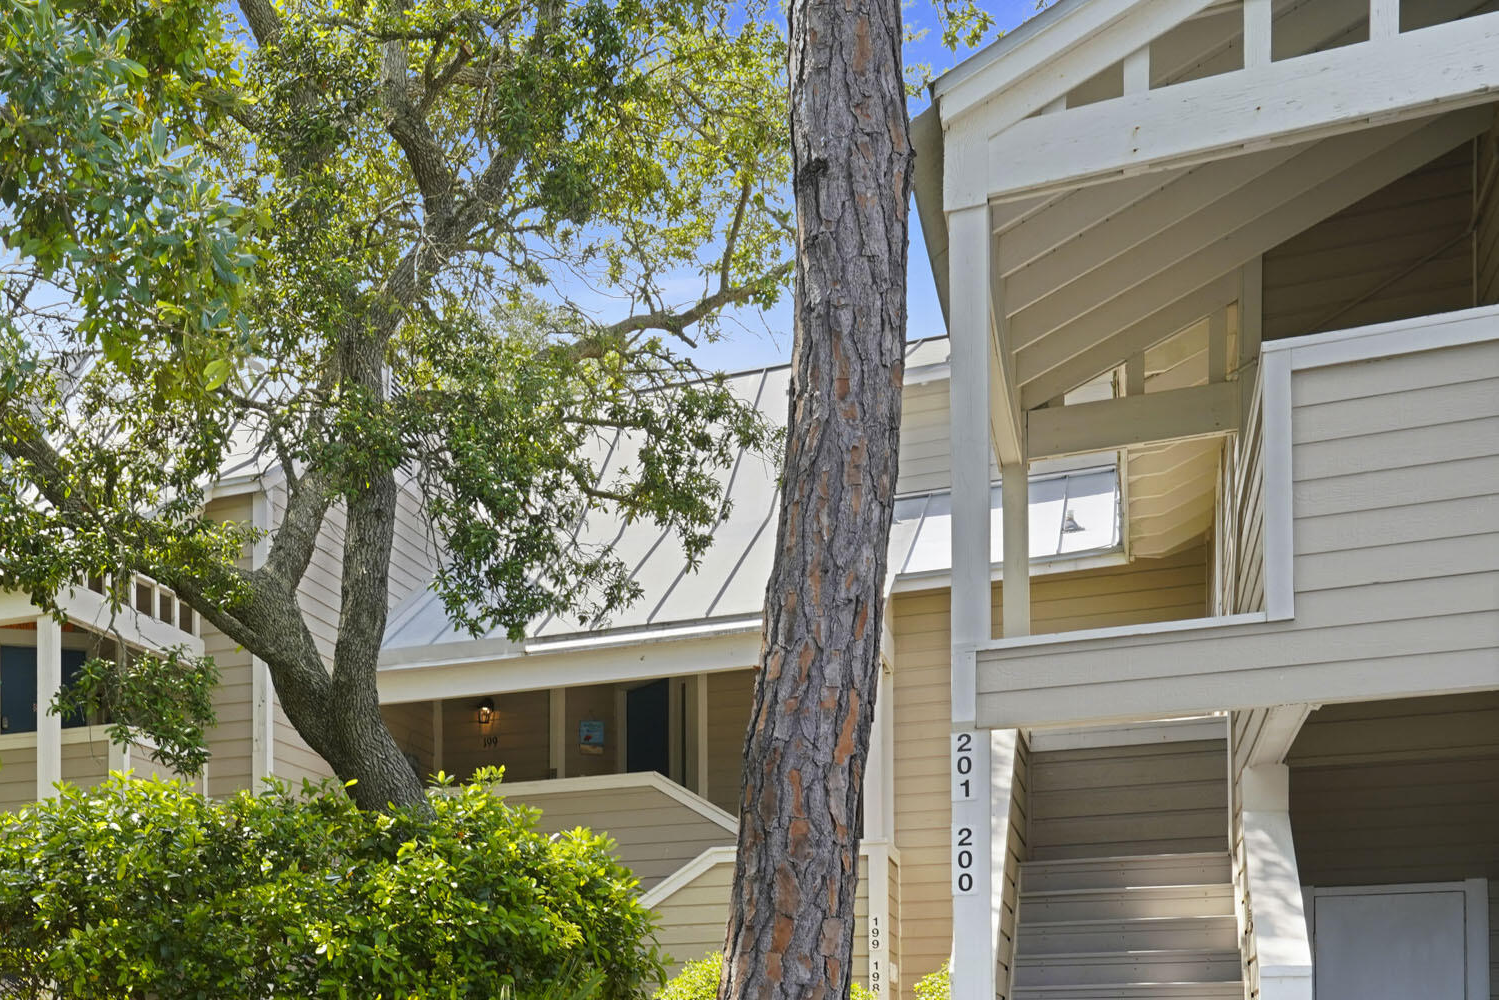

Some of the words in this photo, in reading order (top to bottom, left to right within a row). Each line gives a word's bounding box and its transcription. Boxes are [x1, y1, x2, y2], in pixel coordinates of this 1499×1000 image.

[957, 733, 972, 798] 201
[957, 827, 973, 892] 200
[872, 916, 880, 950] 199
